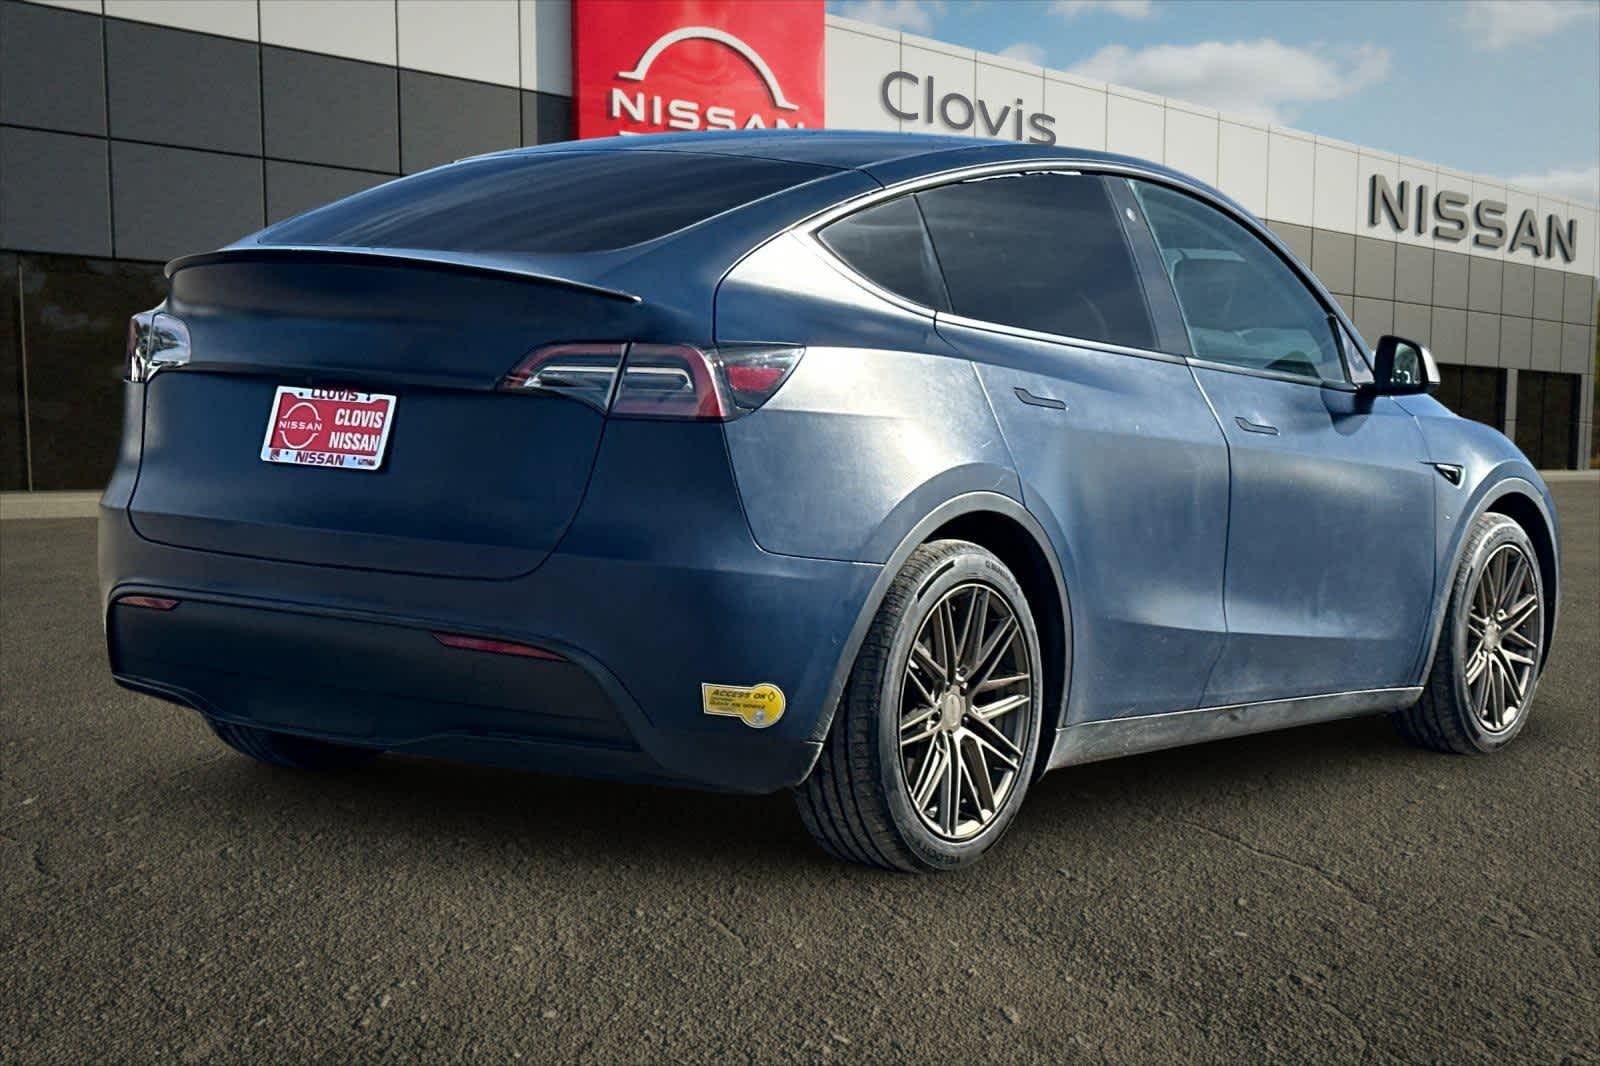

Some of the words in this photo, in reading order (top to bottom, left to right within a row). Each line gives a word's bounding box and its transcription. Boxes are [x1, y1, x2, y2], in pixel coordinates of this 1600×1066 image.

[882, 70, 1057, 145] Clovis
[1368, 174, 1578, 263] NISSAN
[278, 421, 323, 431] NISSAN
[335, 408, 384, 428] CLOVIS
[329, 432, 380, 451] NISSAN
[295, 451, 346, 466] NISSAN
